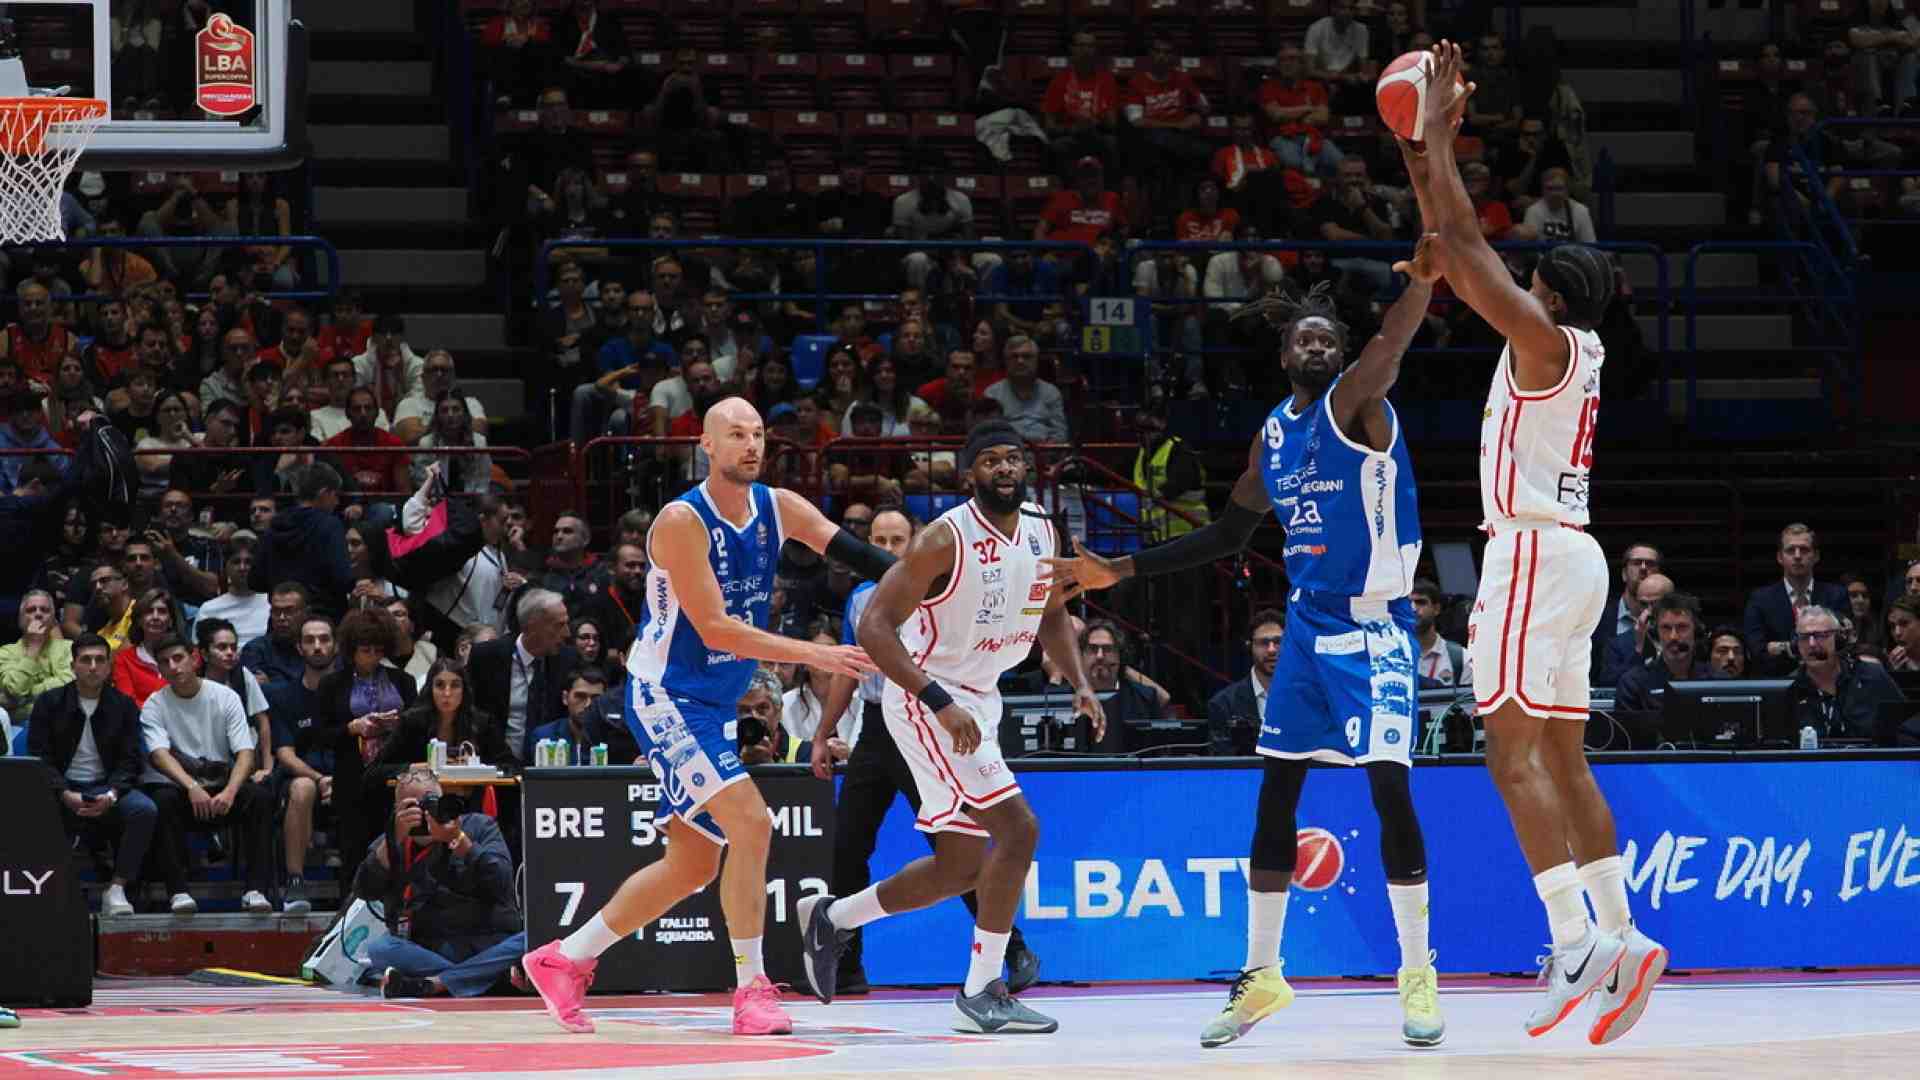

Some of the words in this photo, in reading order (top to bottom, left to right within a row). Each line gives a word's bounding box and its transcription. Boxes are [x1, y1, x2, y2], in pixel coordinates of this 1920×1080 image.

[204, 55, 247, 71] LBA
[1096, 301, 1126, 321] 14
[1266, 416, 1285, 450] 9
[711, 527, 729, 557] 2
[972, 538, 1001, 565] 32
[1345, 716, 1362, 748] 9
[535, 807, 606, 839] BRE
[766, 806, 823, 837] MIL
[3, 870, 55, 895] LY
[1715, 837, 1813, 908] DAY,
[554, 882, 585, 926] 7
[655, 931, 715, 944] SQUADRA
[660, 918, 694, 928] FALLI
[696, 917, 709, 928] DI
